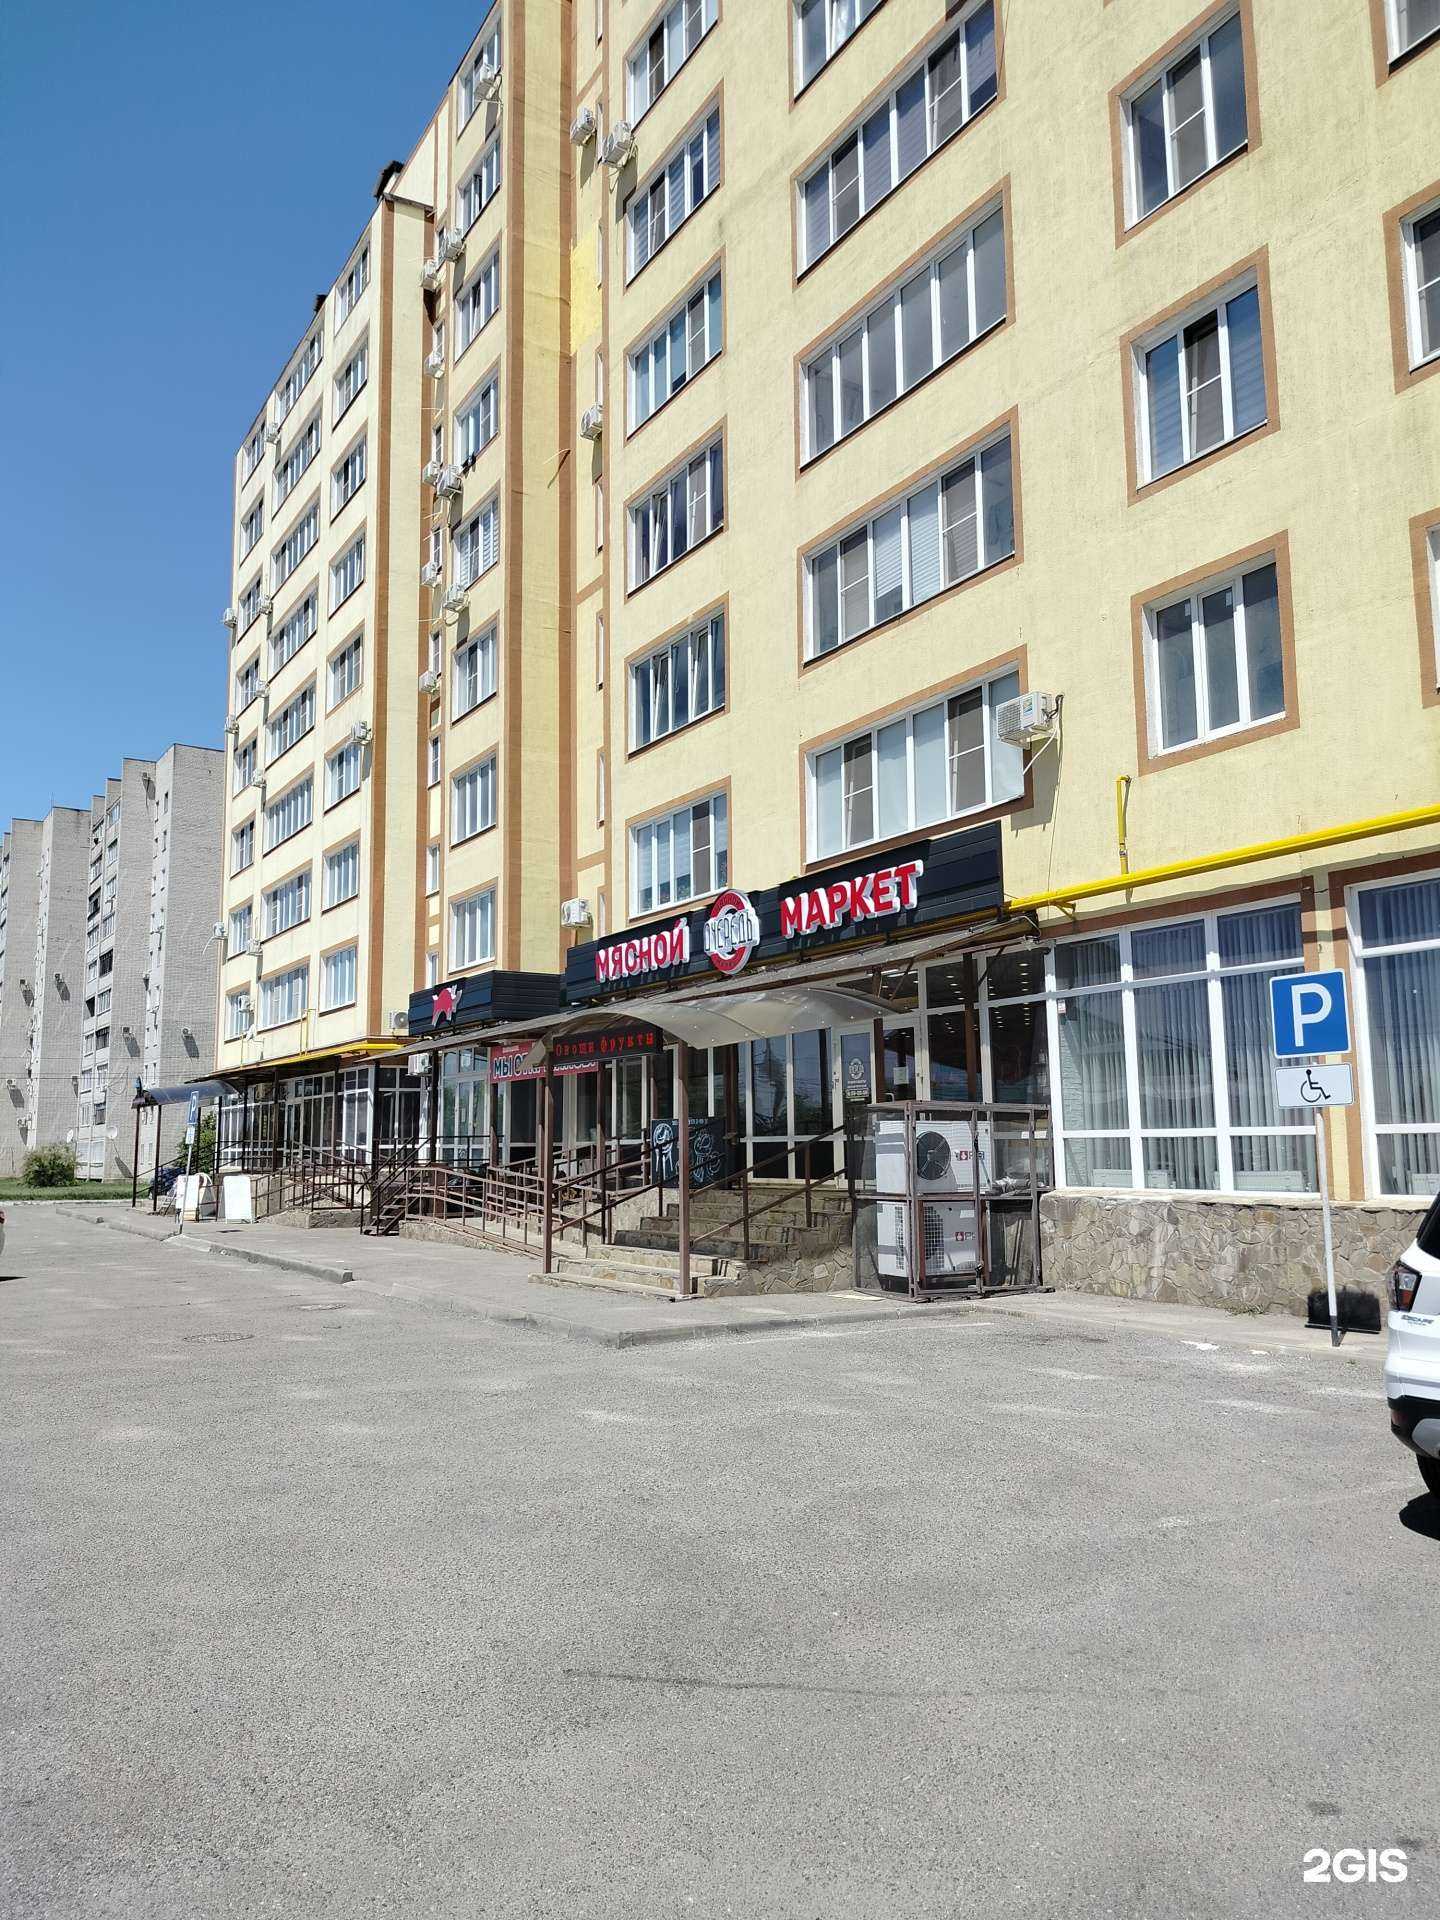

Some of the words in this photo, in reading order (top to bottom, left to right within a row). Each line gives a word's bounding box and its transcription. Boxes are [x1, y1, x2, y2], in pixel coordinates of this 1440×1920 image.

[594, 917, 690, 984] МЯСНОЙ
[780, 860, 924, 939] МАРКЕТ
[704, 911, 753, 952] ОЧЕРЕДЬ
[1291, 982, 1332, 1047] P
